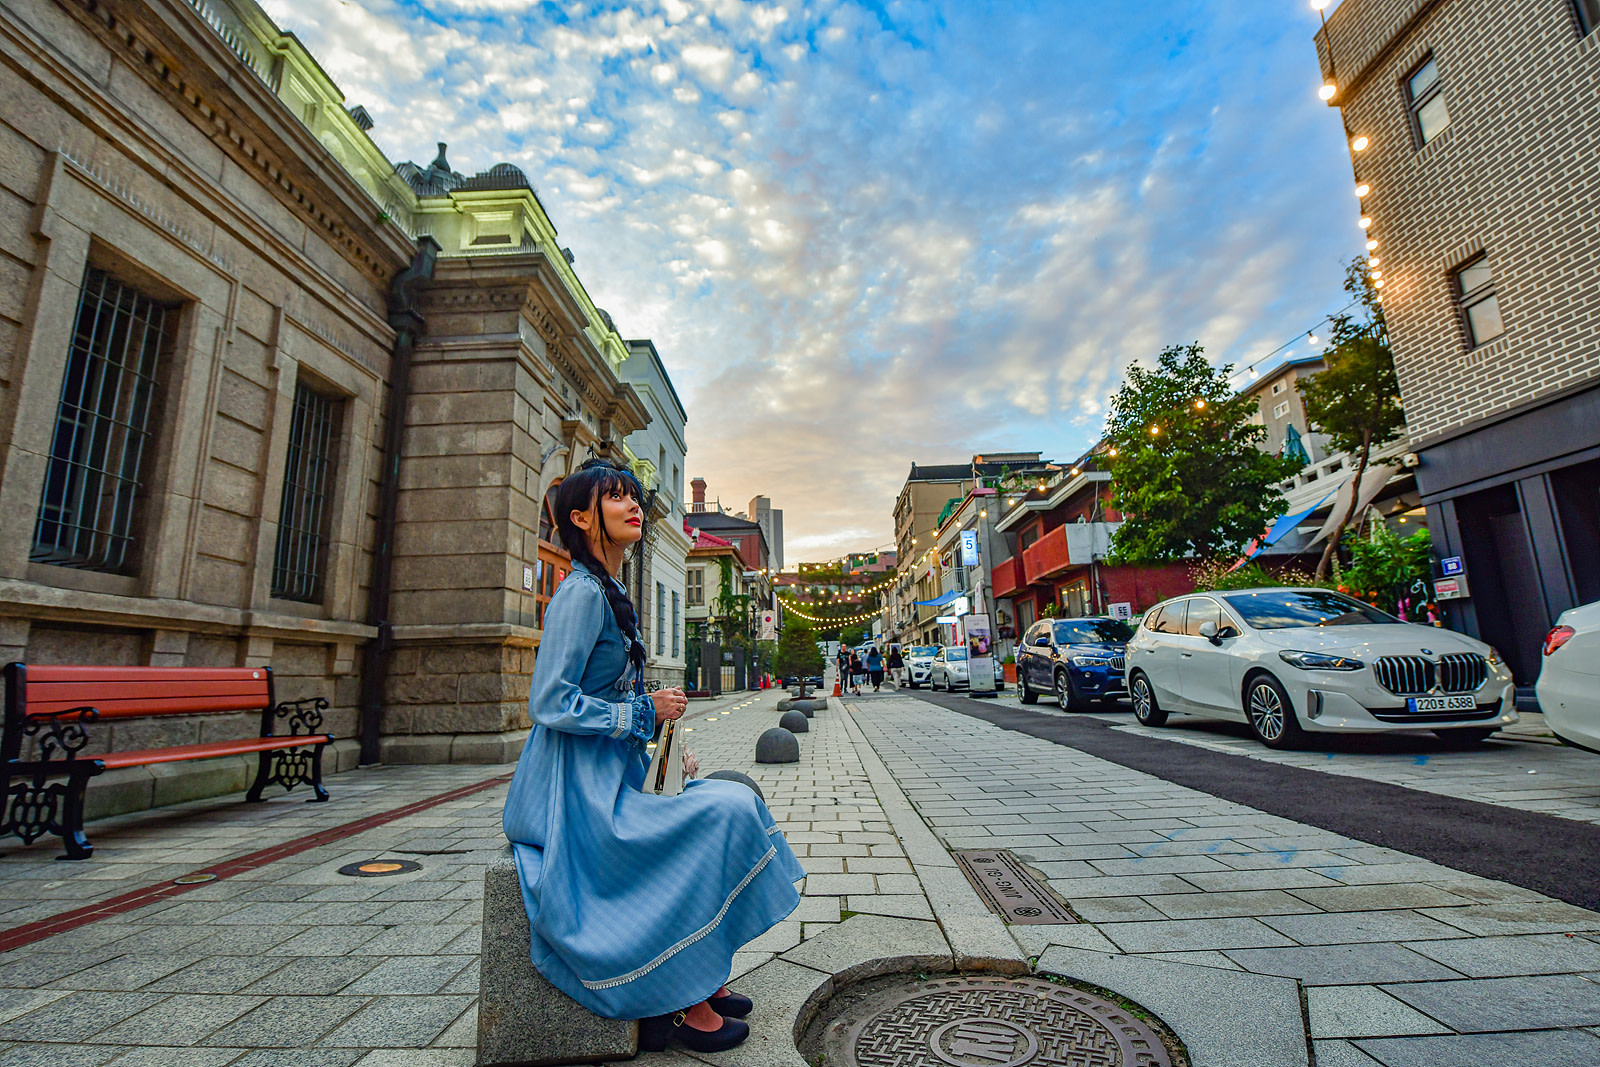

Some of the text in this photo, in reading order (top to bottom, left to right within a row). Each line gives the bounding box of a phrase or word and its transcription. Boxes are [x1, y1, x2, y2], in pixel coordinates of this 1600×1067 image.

[965, 539, 973, 550] 5
[1447, 696, 1474, 709] 6388
[983, 868, 1023, 899] JUNG-GU
